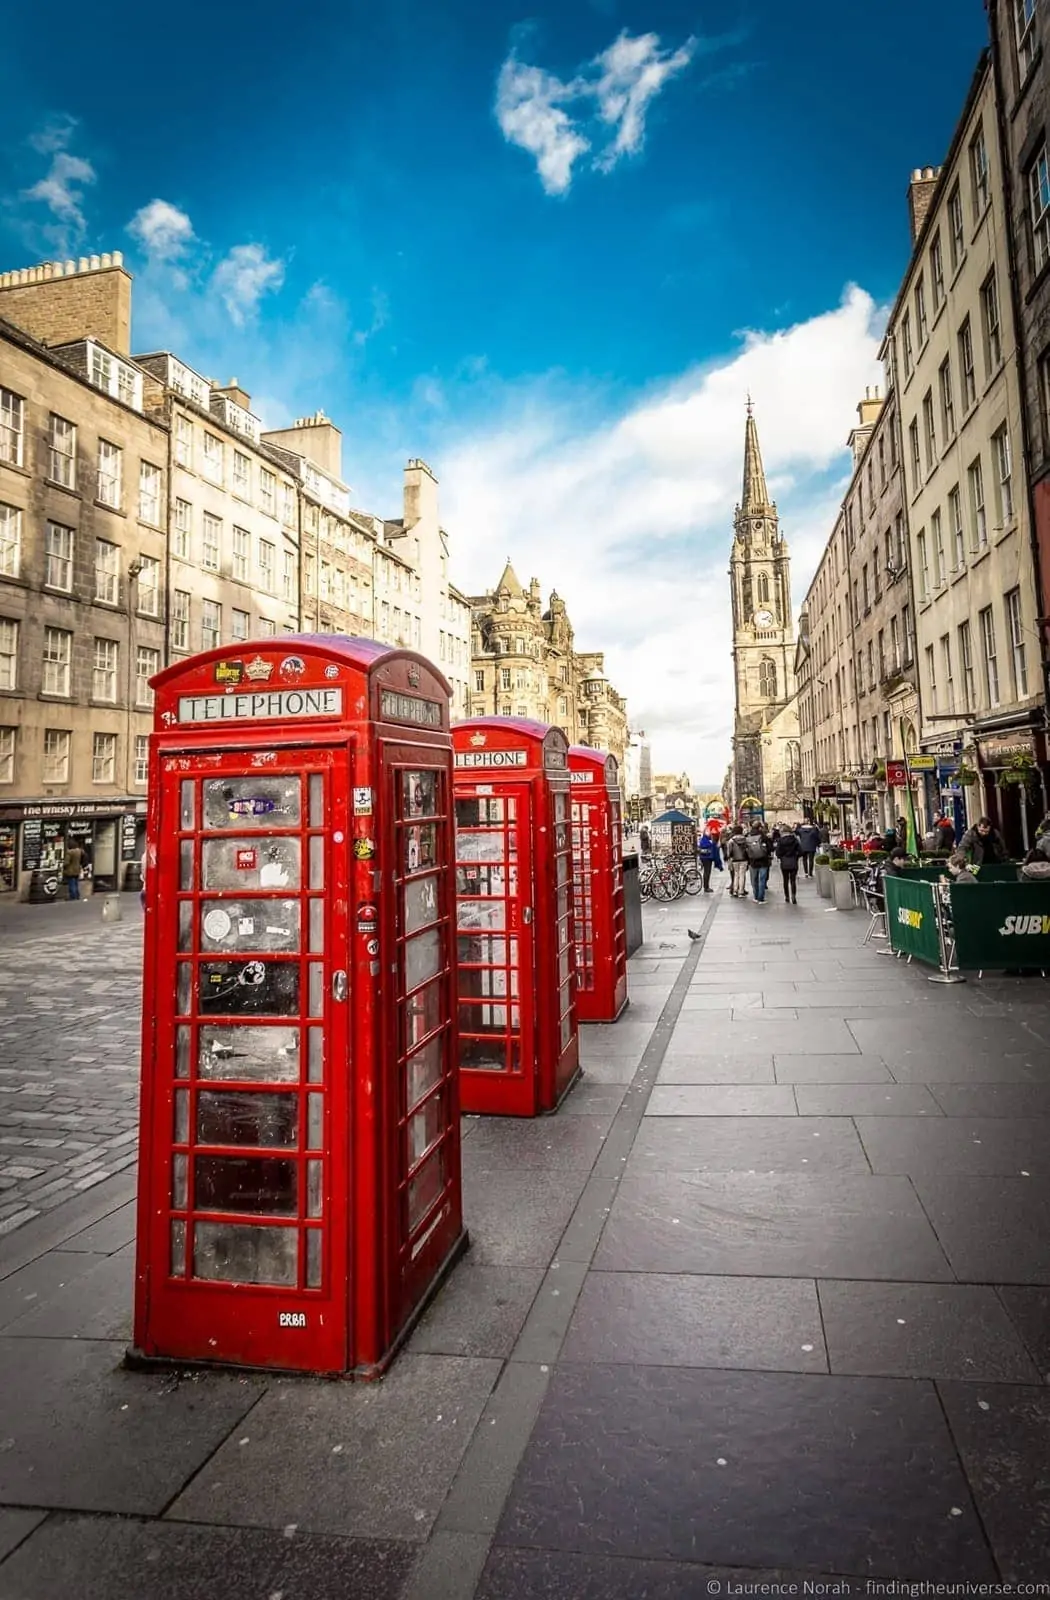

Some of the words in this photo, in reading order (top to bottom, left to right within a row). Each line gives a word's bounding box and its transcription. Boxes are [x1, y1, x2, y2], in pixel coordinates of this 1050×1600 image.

[187, 691, 336, 720] TELEPHONE
[23, 807, 41, 815] The
[42, 805, 75, 816] Whisky
[77, 804, 95, 812] Trail
[674, 825, 692, 835] FREE
[672, 835, 694, 845] GHOST
[898, 907, 923, 929] SUBWAY
